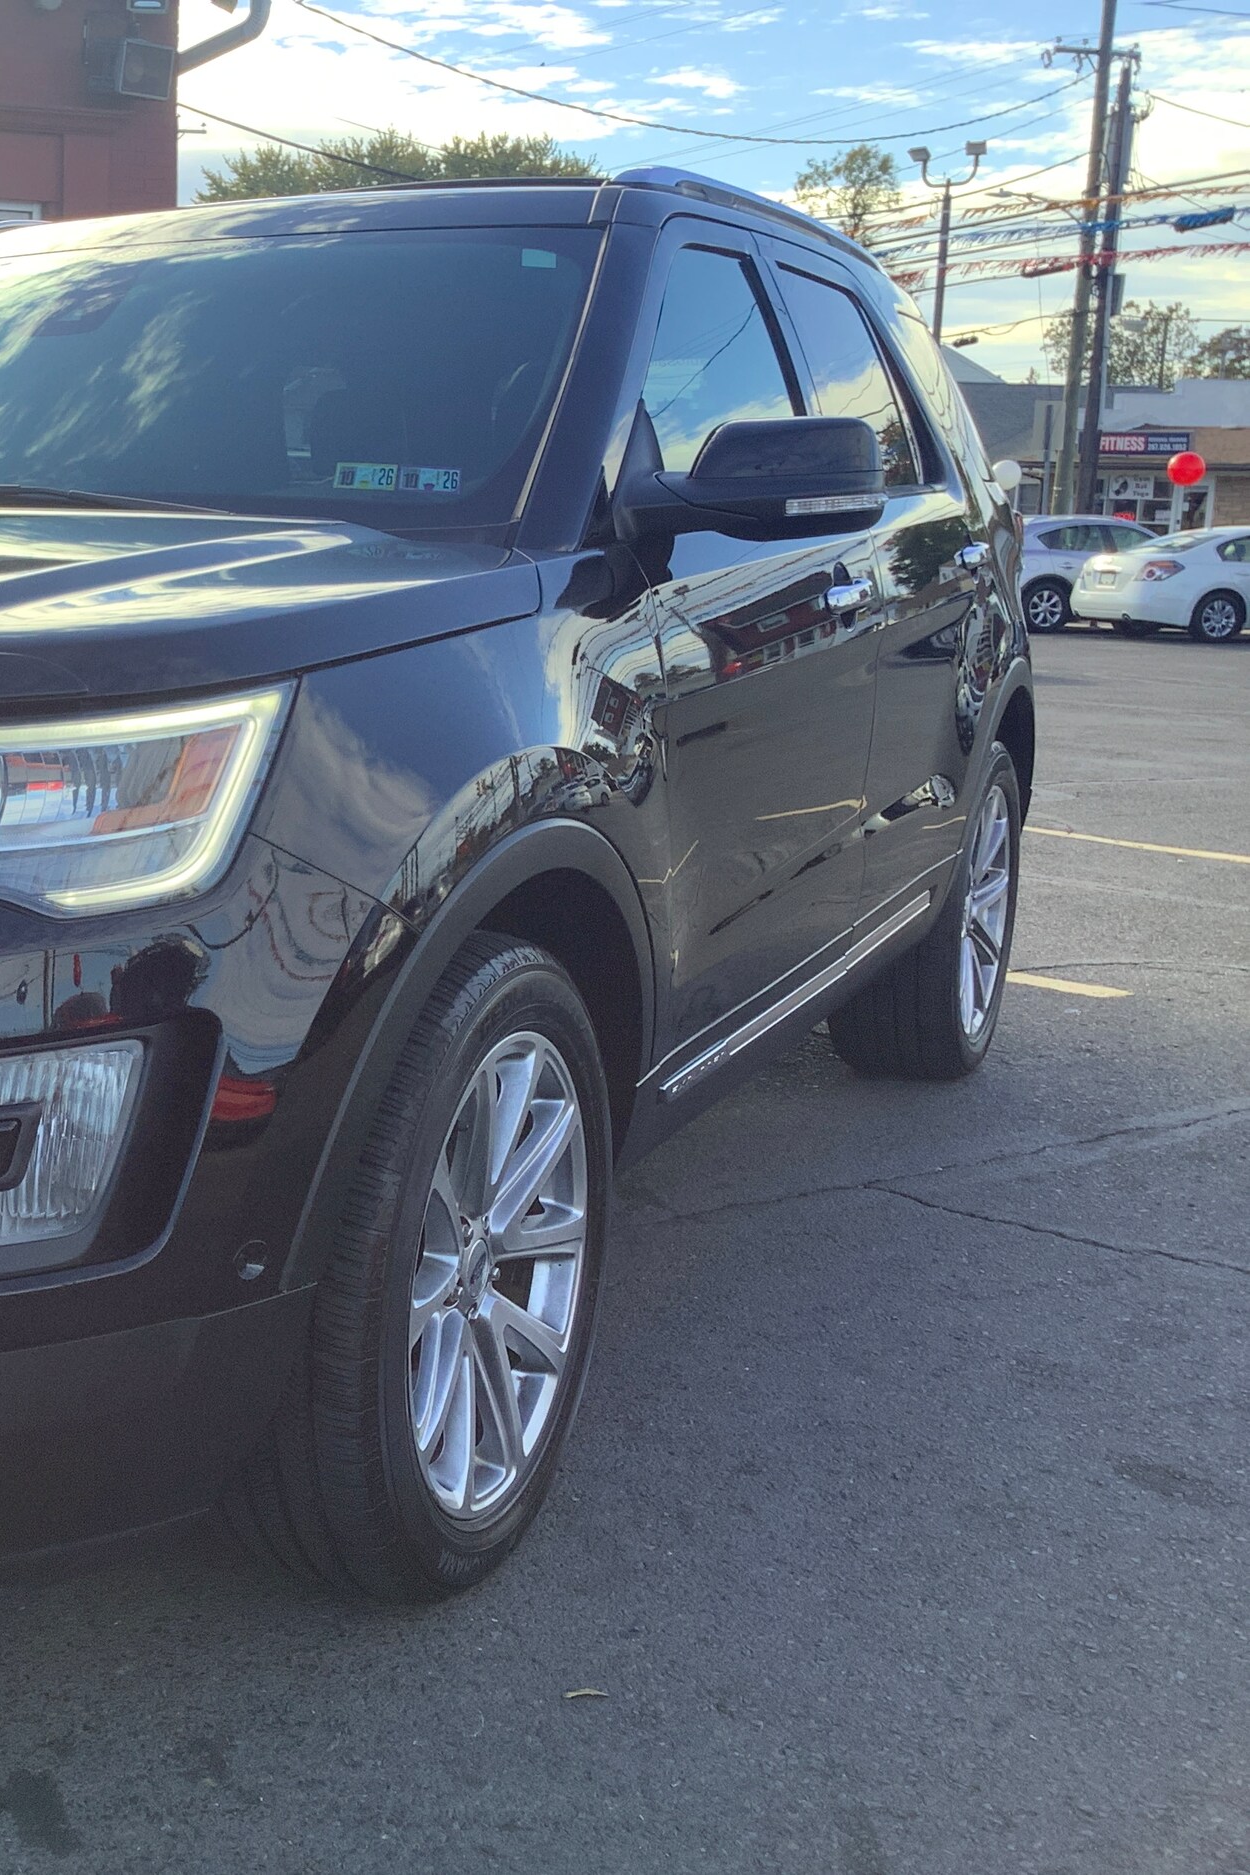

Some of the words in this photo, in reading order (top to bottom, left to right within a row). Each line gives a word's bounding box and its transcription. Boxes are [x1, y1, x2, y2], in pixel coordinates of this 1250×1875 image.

[1099, 436, 1145, 451] FITNESS
[378, 467, 394, 486] 26
[443, 470, 459, 489] 26
